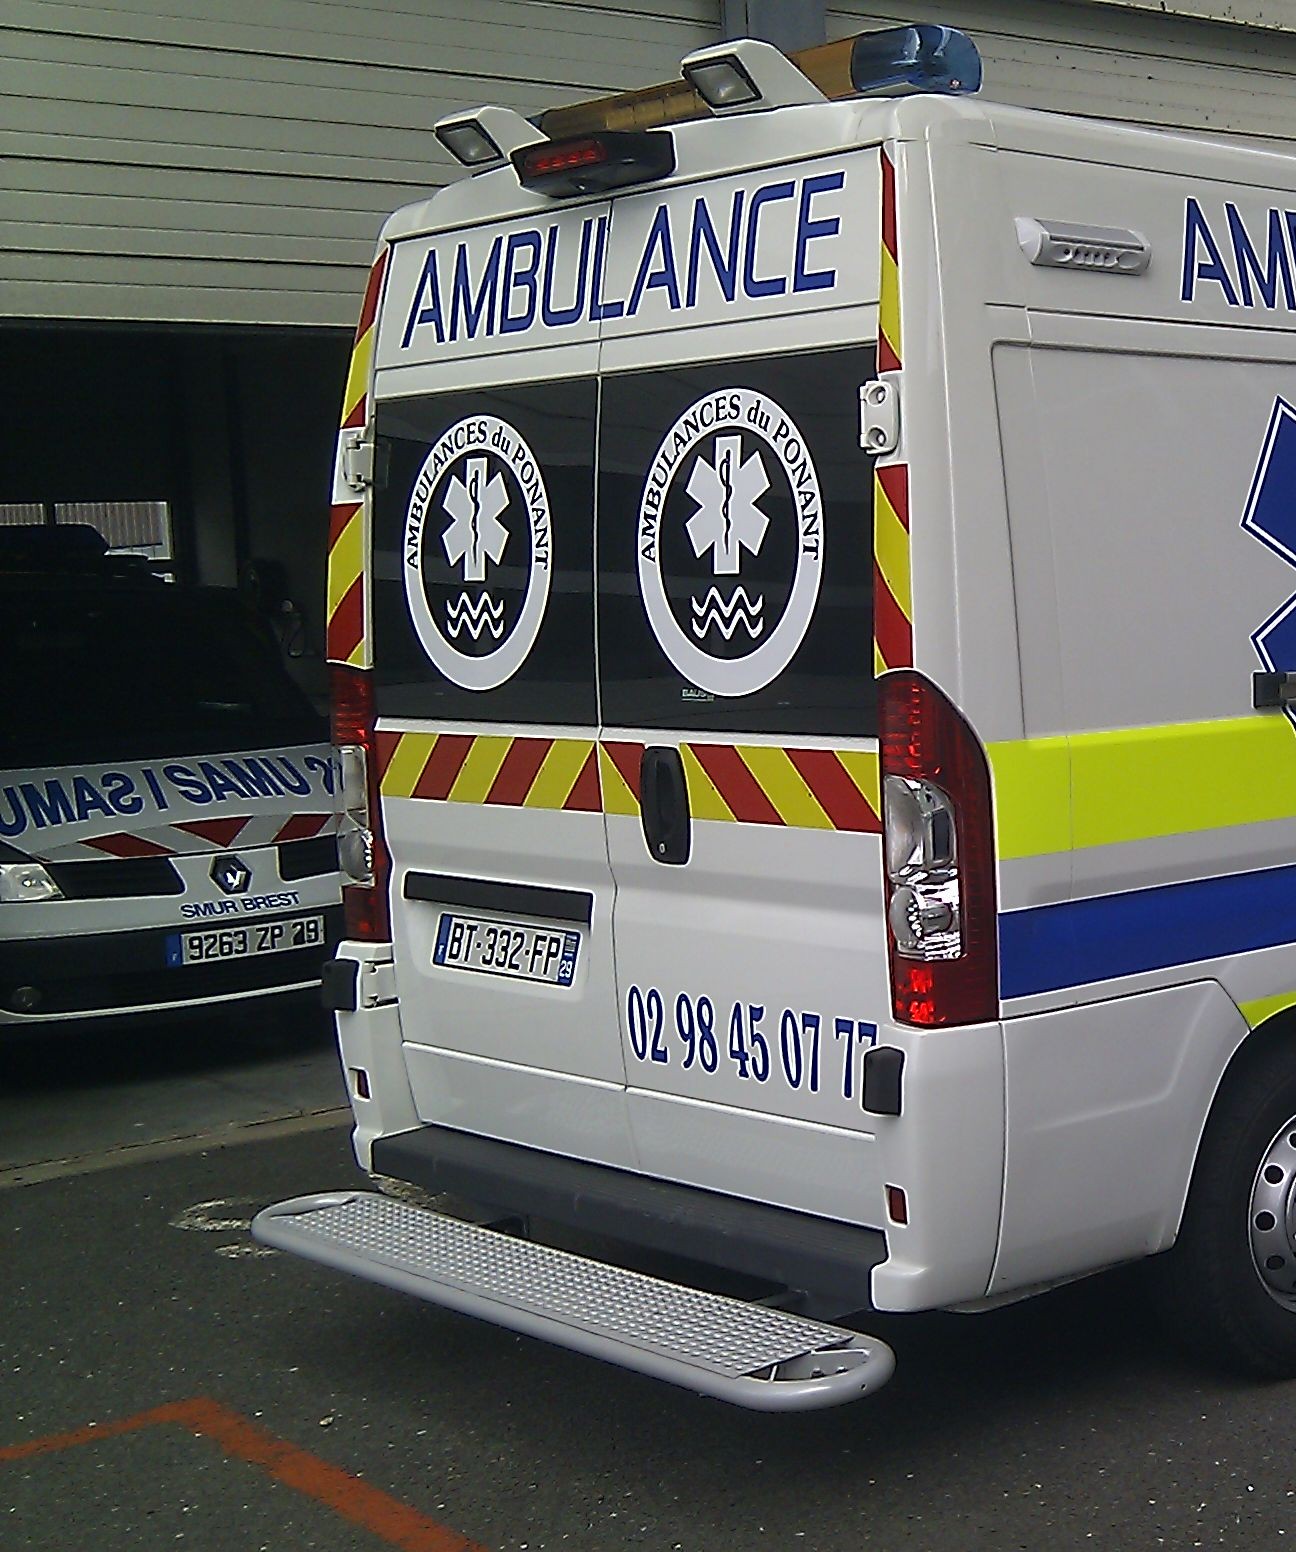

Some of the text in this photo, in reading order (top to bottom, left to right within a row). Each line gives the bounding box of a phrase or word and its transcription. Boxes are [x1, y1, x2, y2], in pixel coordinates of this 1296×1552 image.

[400, 171, 846, 350] AMBULANCE
[406, 420, 549, 571] AMBULANCES du PONANT
[641, 393, 820, 562] AMBULANCES du PONANT
[163, 755, 312, 806] SAMU
[180, 891, 300, 919] SMUR BREST
[188, 929, 248, 961] 9263
[255, 925, 284, 952] ZP
[291, 919, 319, 946] 29
[559, 960, 573, 978] 29
[628, 984, 669, 1065] 02
[674, 991, 719, 1073] 98
[728, 1001, 771, 1083] 45
[779, 1008, 821, 1093] 07
